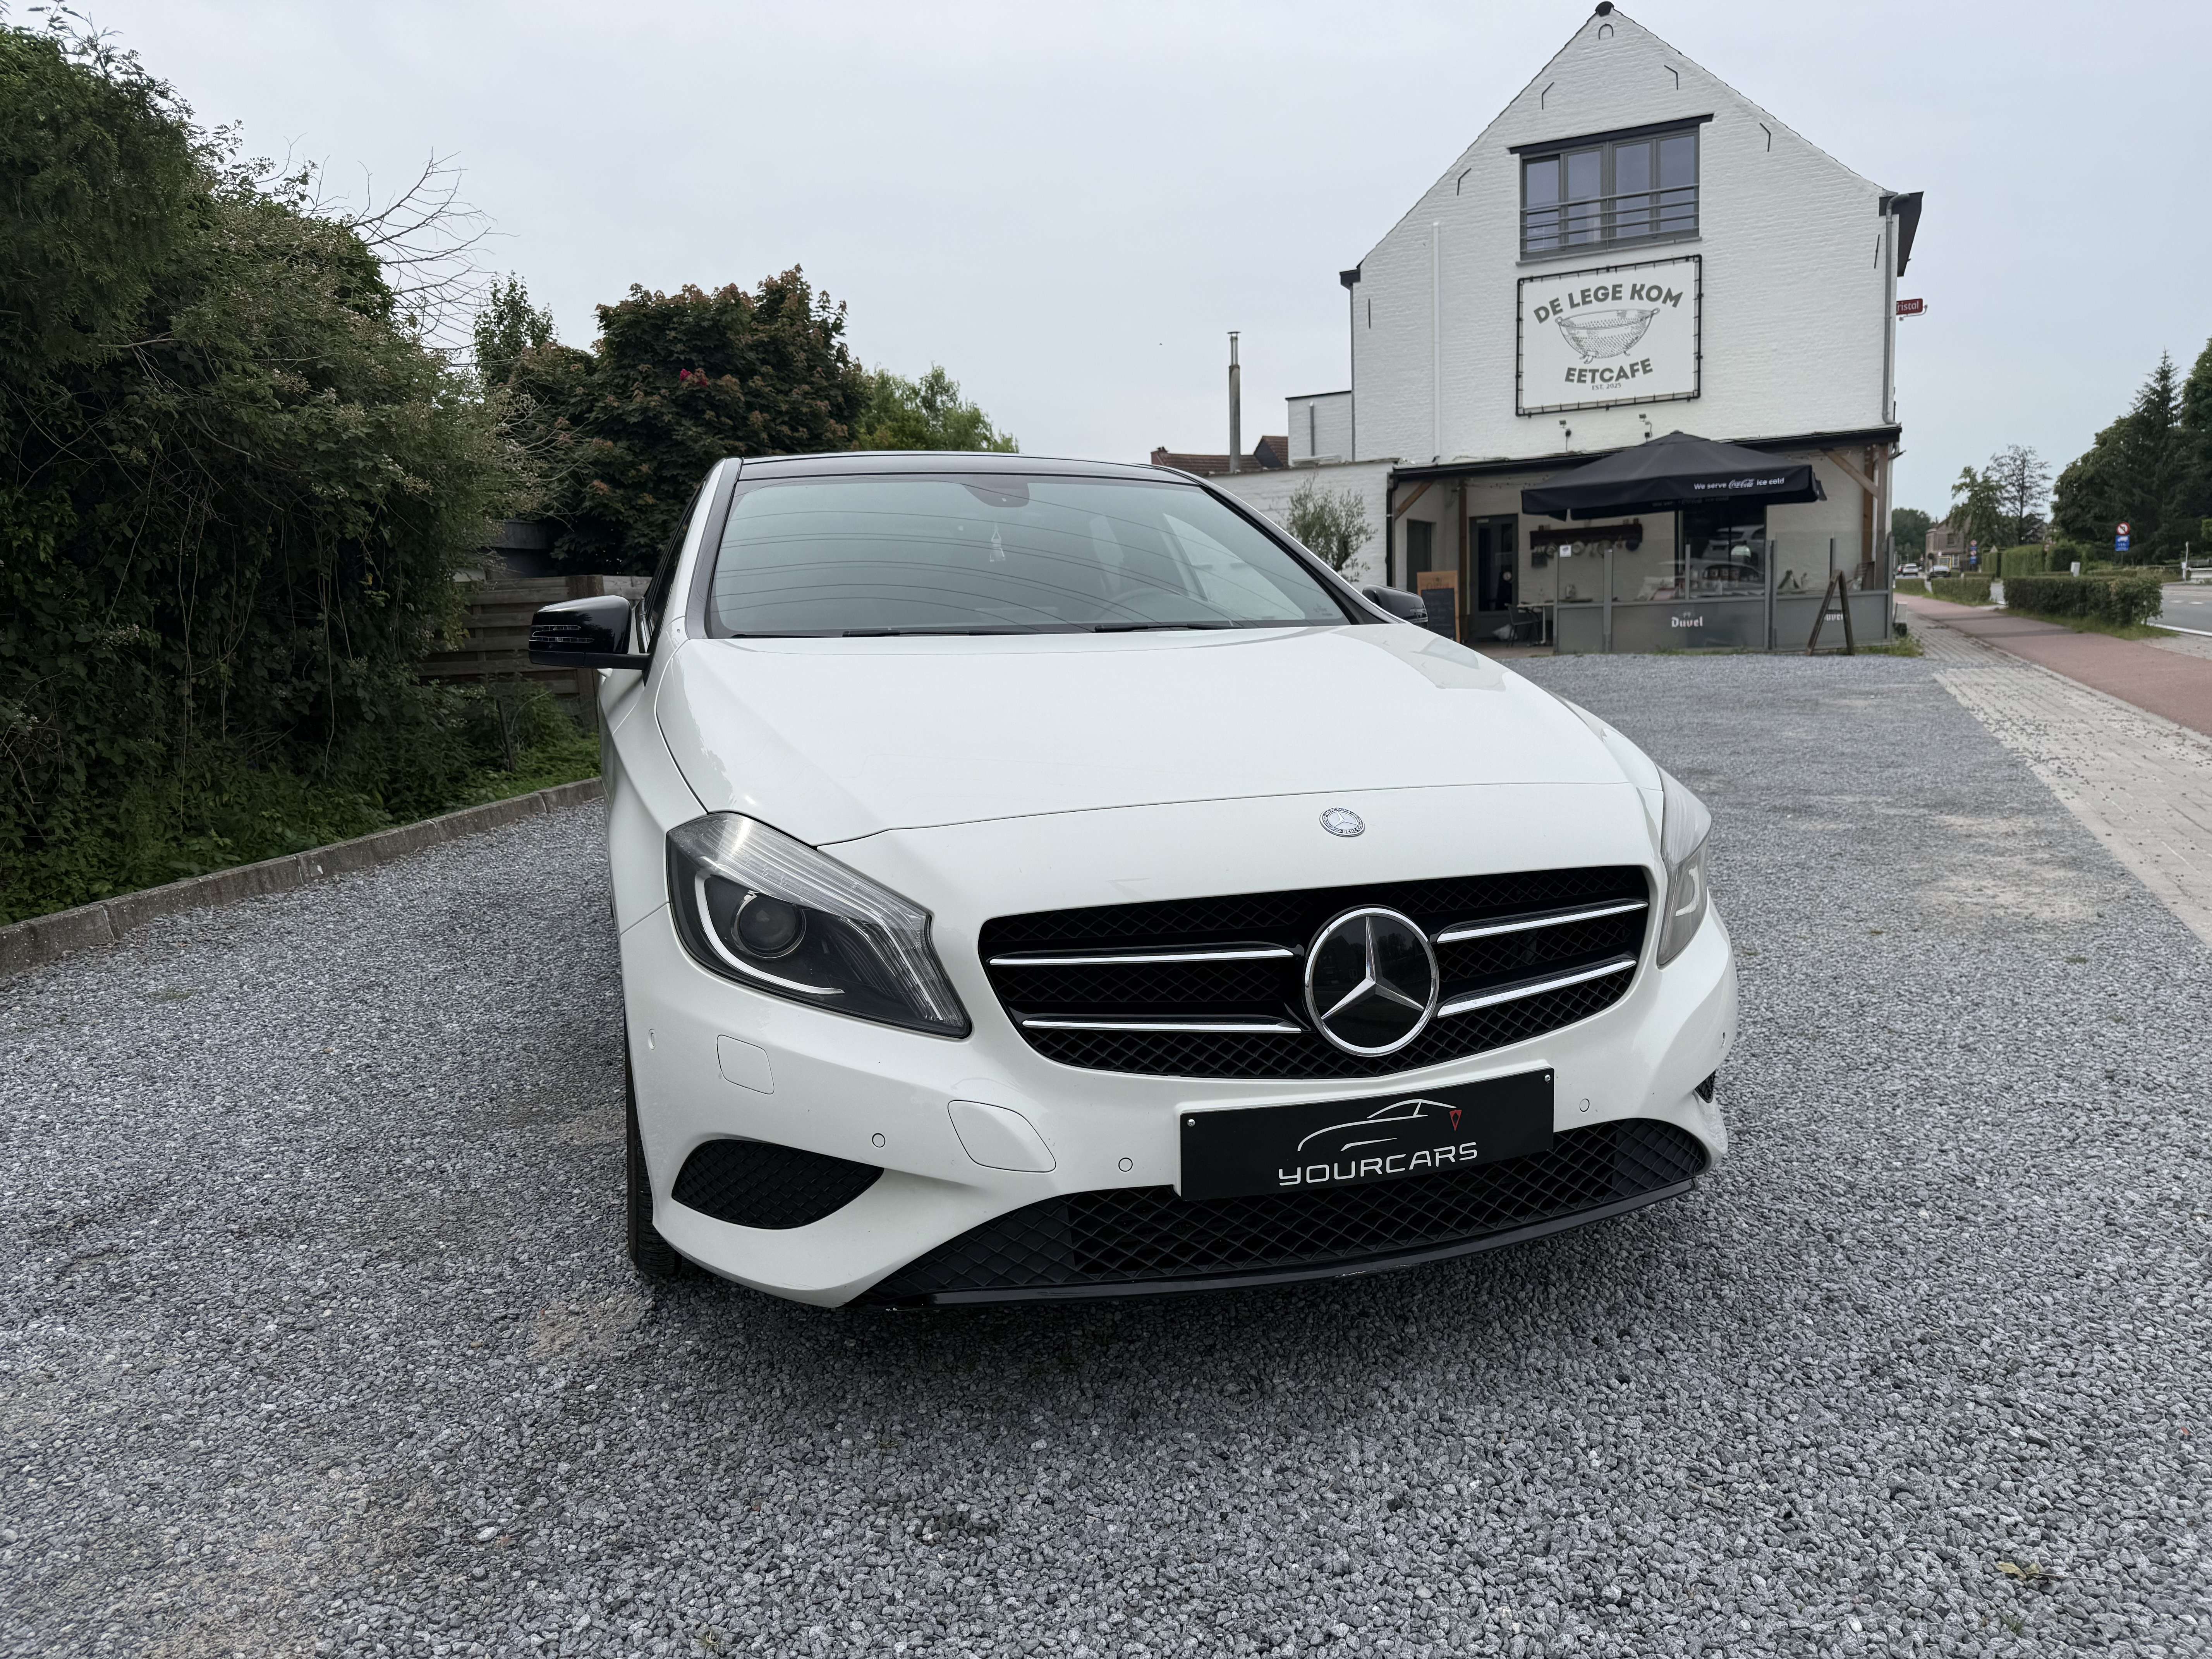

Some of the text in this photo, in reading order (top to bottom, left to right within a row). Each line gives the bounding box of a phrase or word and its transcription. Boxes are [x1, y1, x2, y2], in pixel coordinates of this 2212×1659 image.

[1534, 283, 1683, 324] DE LEGE KOM
[1897, 301, 1919, 312] ristal
[1565, 358, 1653, 384] EETCAFE
[1769, 477, 1784, 485] cold
[1671, 616, 1703, 626] Duvel
[1825, 613, 1843, 622] uvel
[1279, 1142, 1478, 1186] YOURCARS
